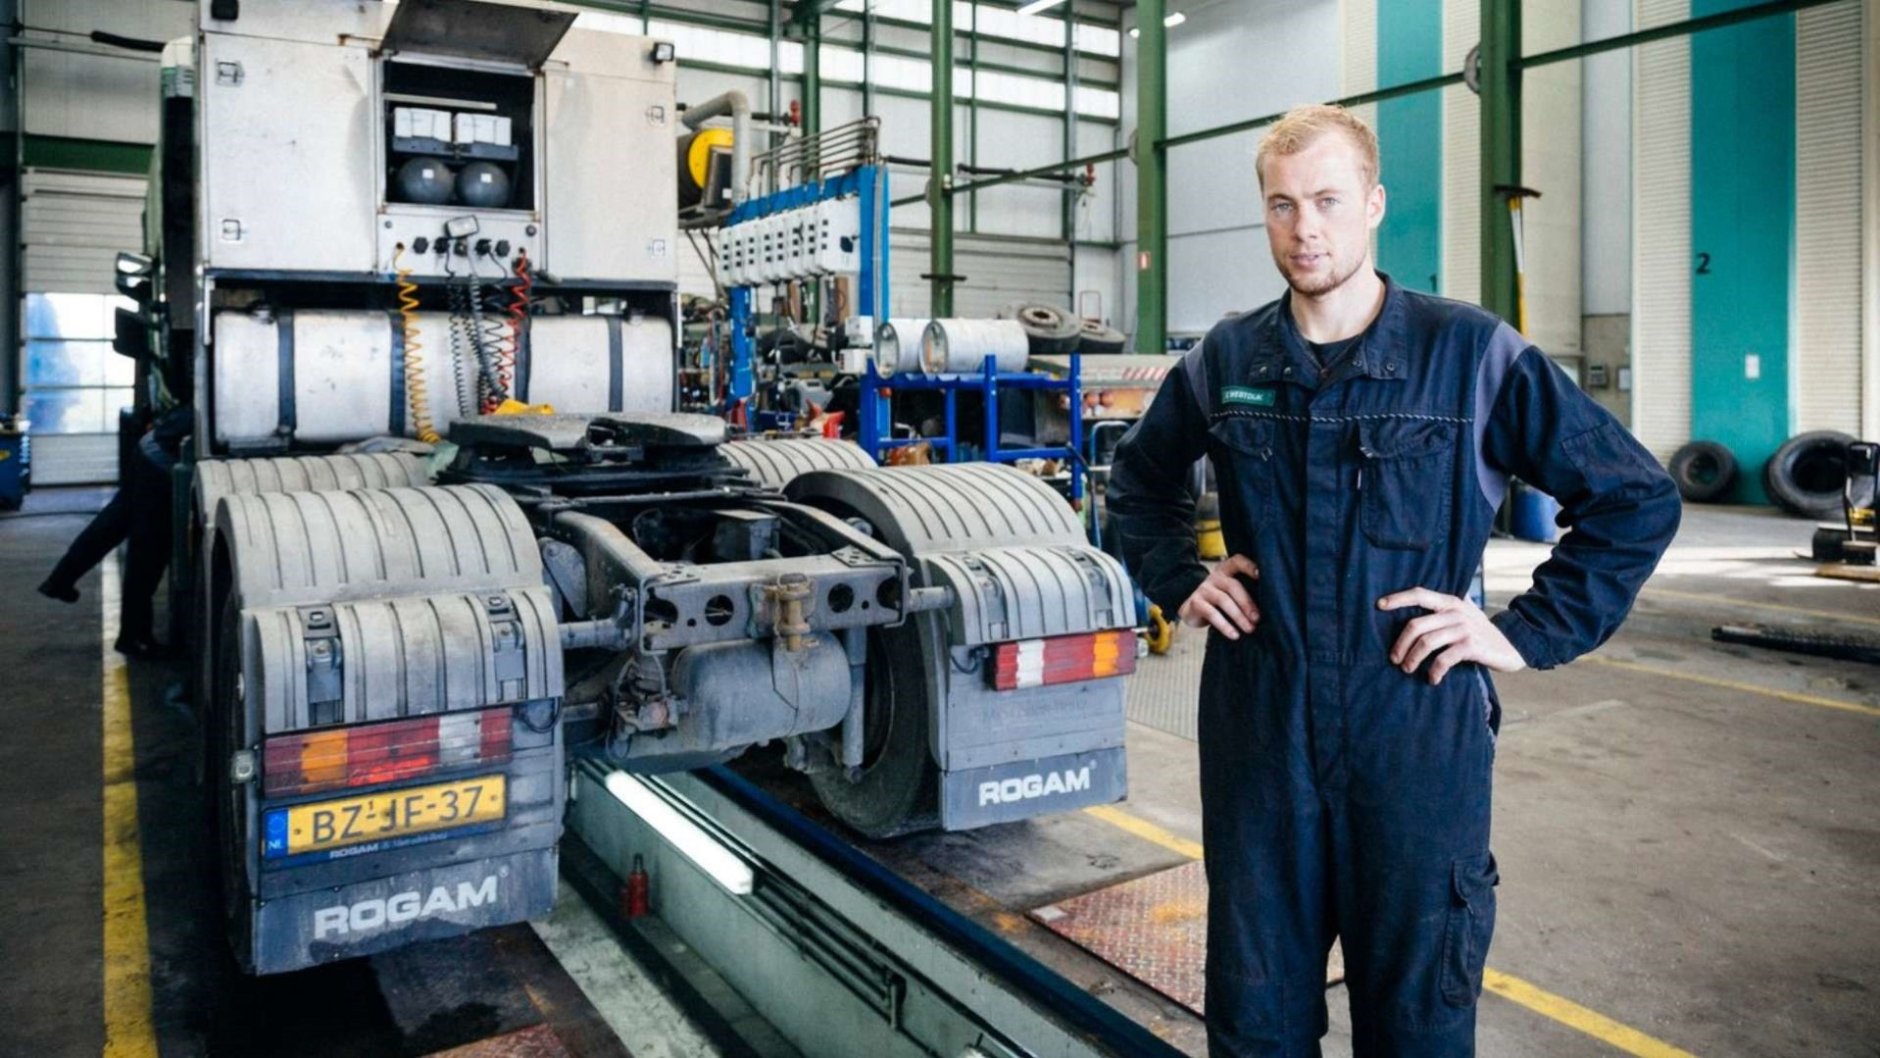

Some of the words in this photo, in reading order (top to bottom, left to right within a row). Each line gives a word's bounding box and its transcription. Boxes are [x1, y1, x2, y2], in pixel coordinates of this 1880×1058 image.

[1696, 252, 1711, 275] 2
[978, 766, 1090, 806] ROGAM
[313, 787, 483, 844] BZ-JF-37
[314, 875, 497, 939] ROGAM
